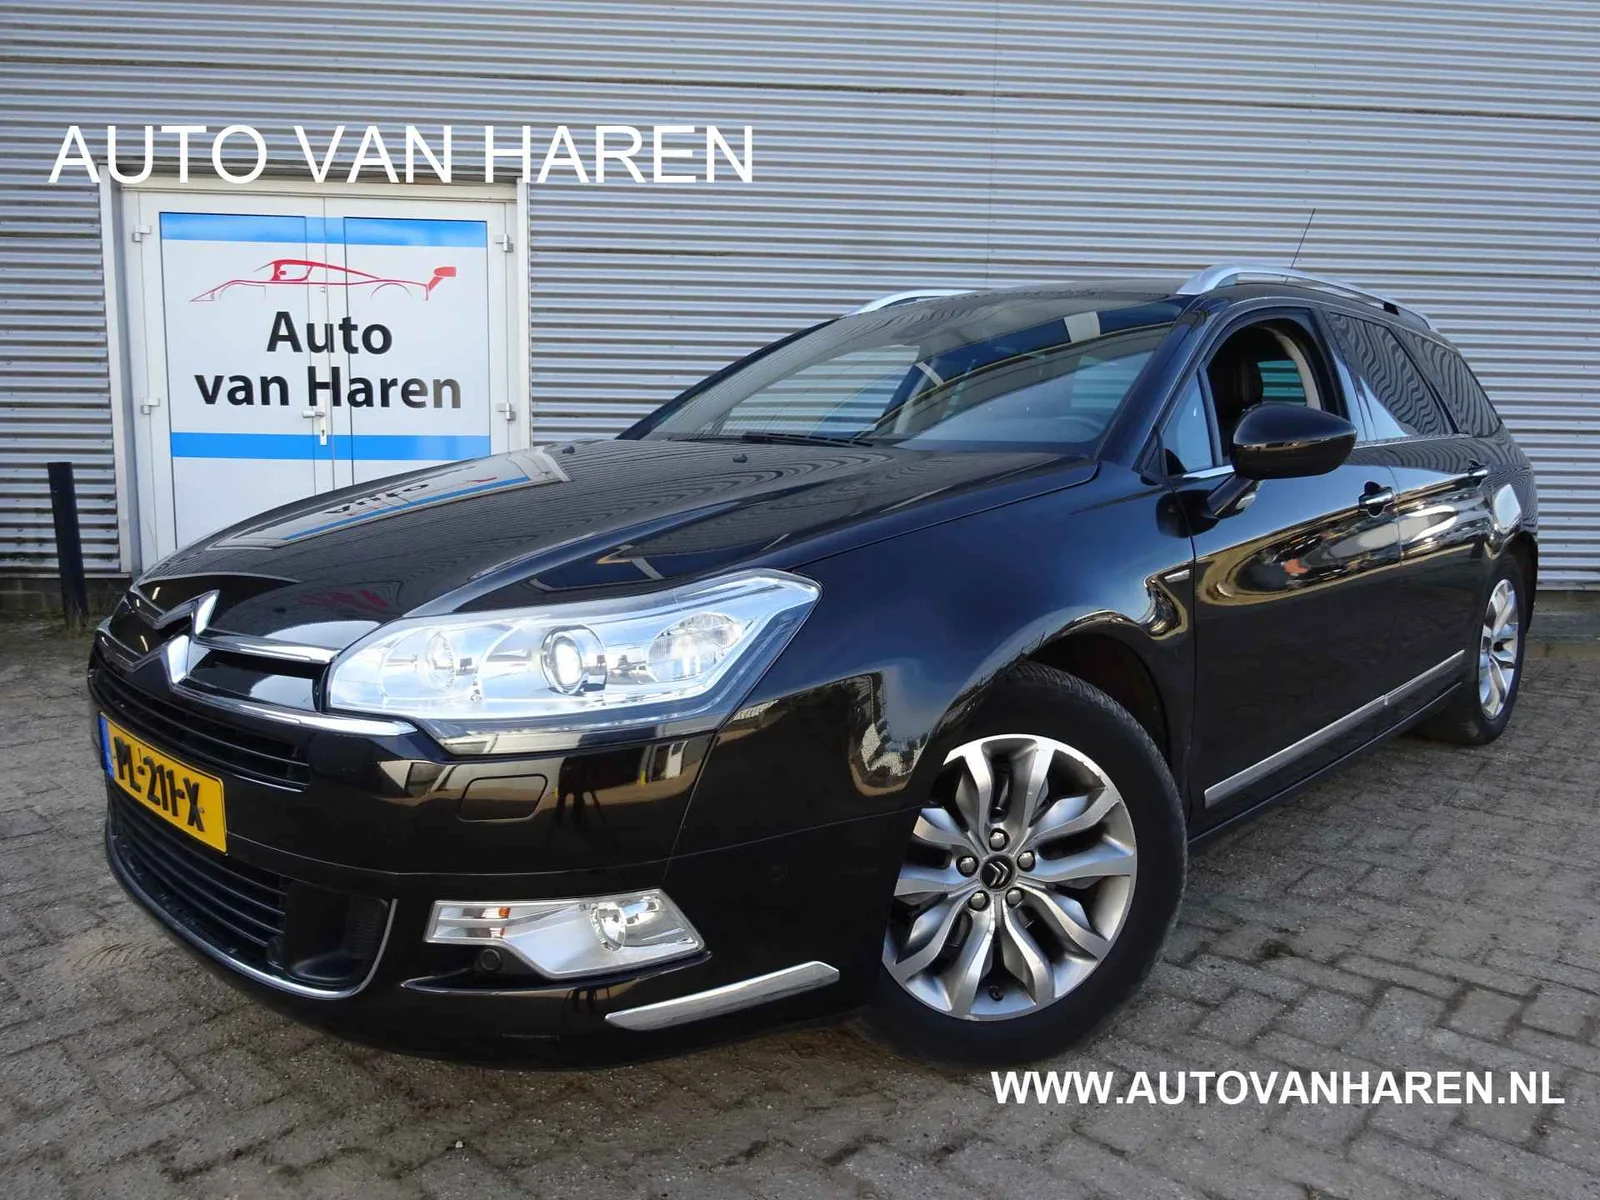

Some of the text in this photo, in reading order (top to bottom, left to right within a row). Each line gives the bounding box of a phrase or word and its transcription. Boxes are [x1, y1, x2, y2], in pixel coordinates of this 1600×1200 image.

[266, 311, 393, 355] Auto
[194, 366, 462, 409] van Haren
